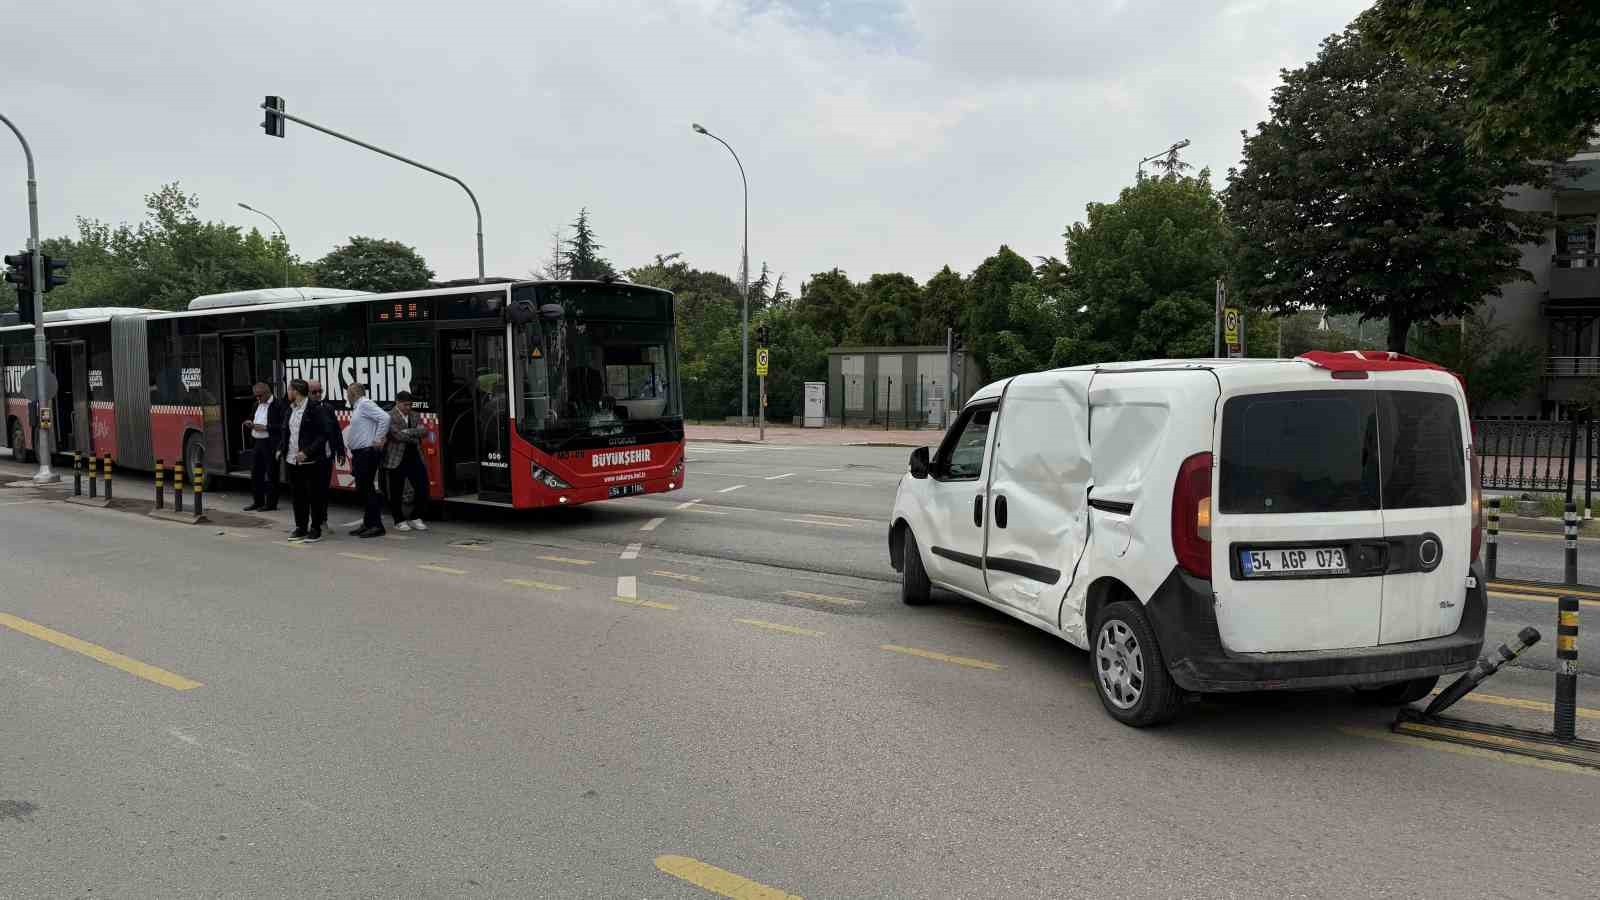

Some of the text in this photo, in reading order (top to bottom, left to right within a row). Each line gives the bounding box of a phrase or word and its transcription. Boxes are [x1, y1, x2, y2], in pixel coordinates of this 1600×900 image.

[592, 449, 651, 467] BÜYÜKŞEHİR
[1251, 552, 1271, 570] 54
[1281, 550, 1306, 569] AGP
[1316, 549, 1345, 568] 073
